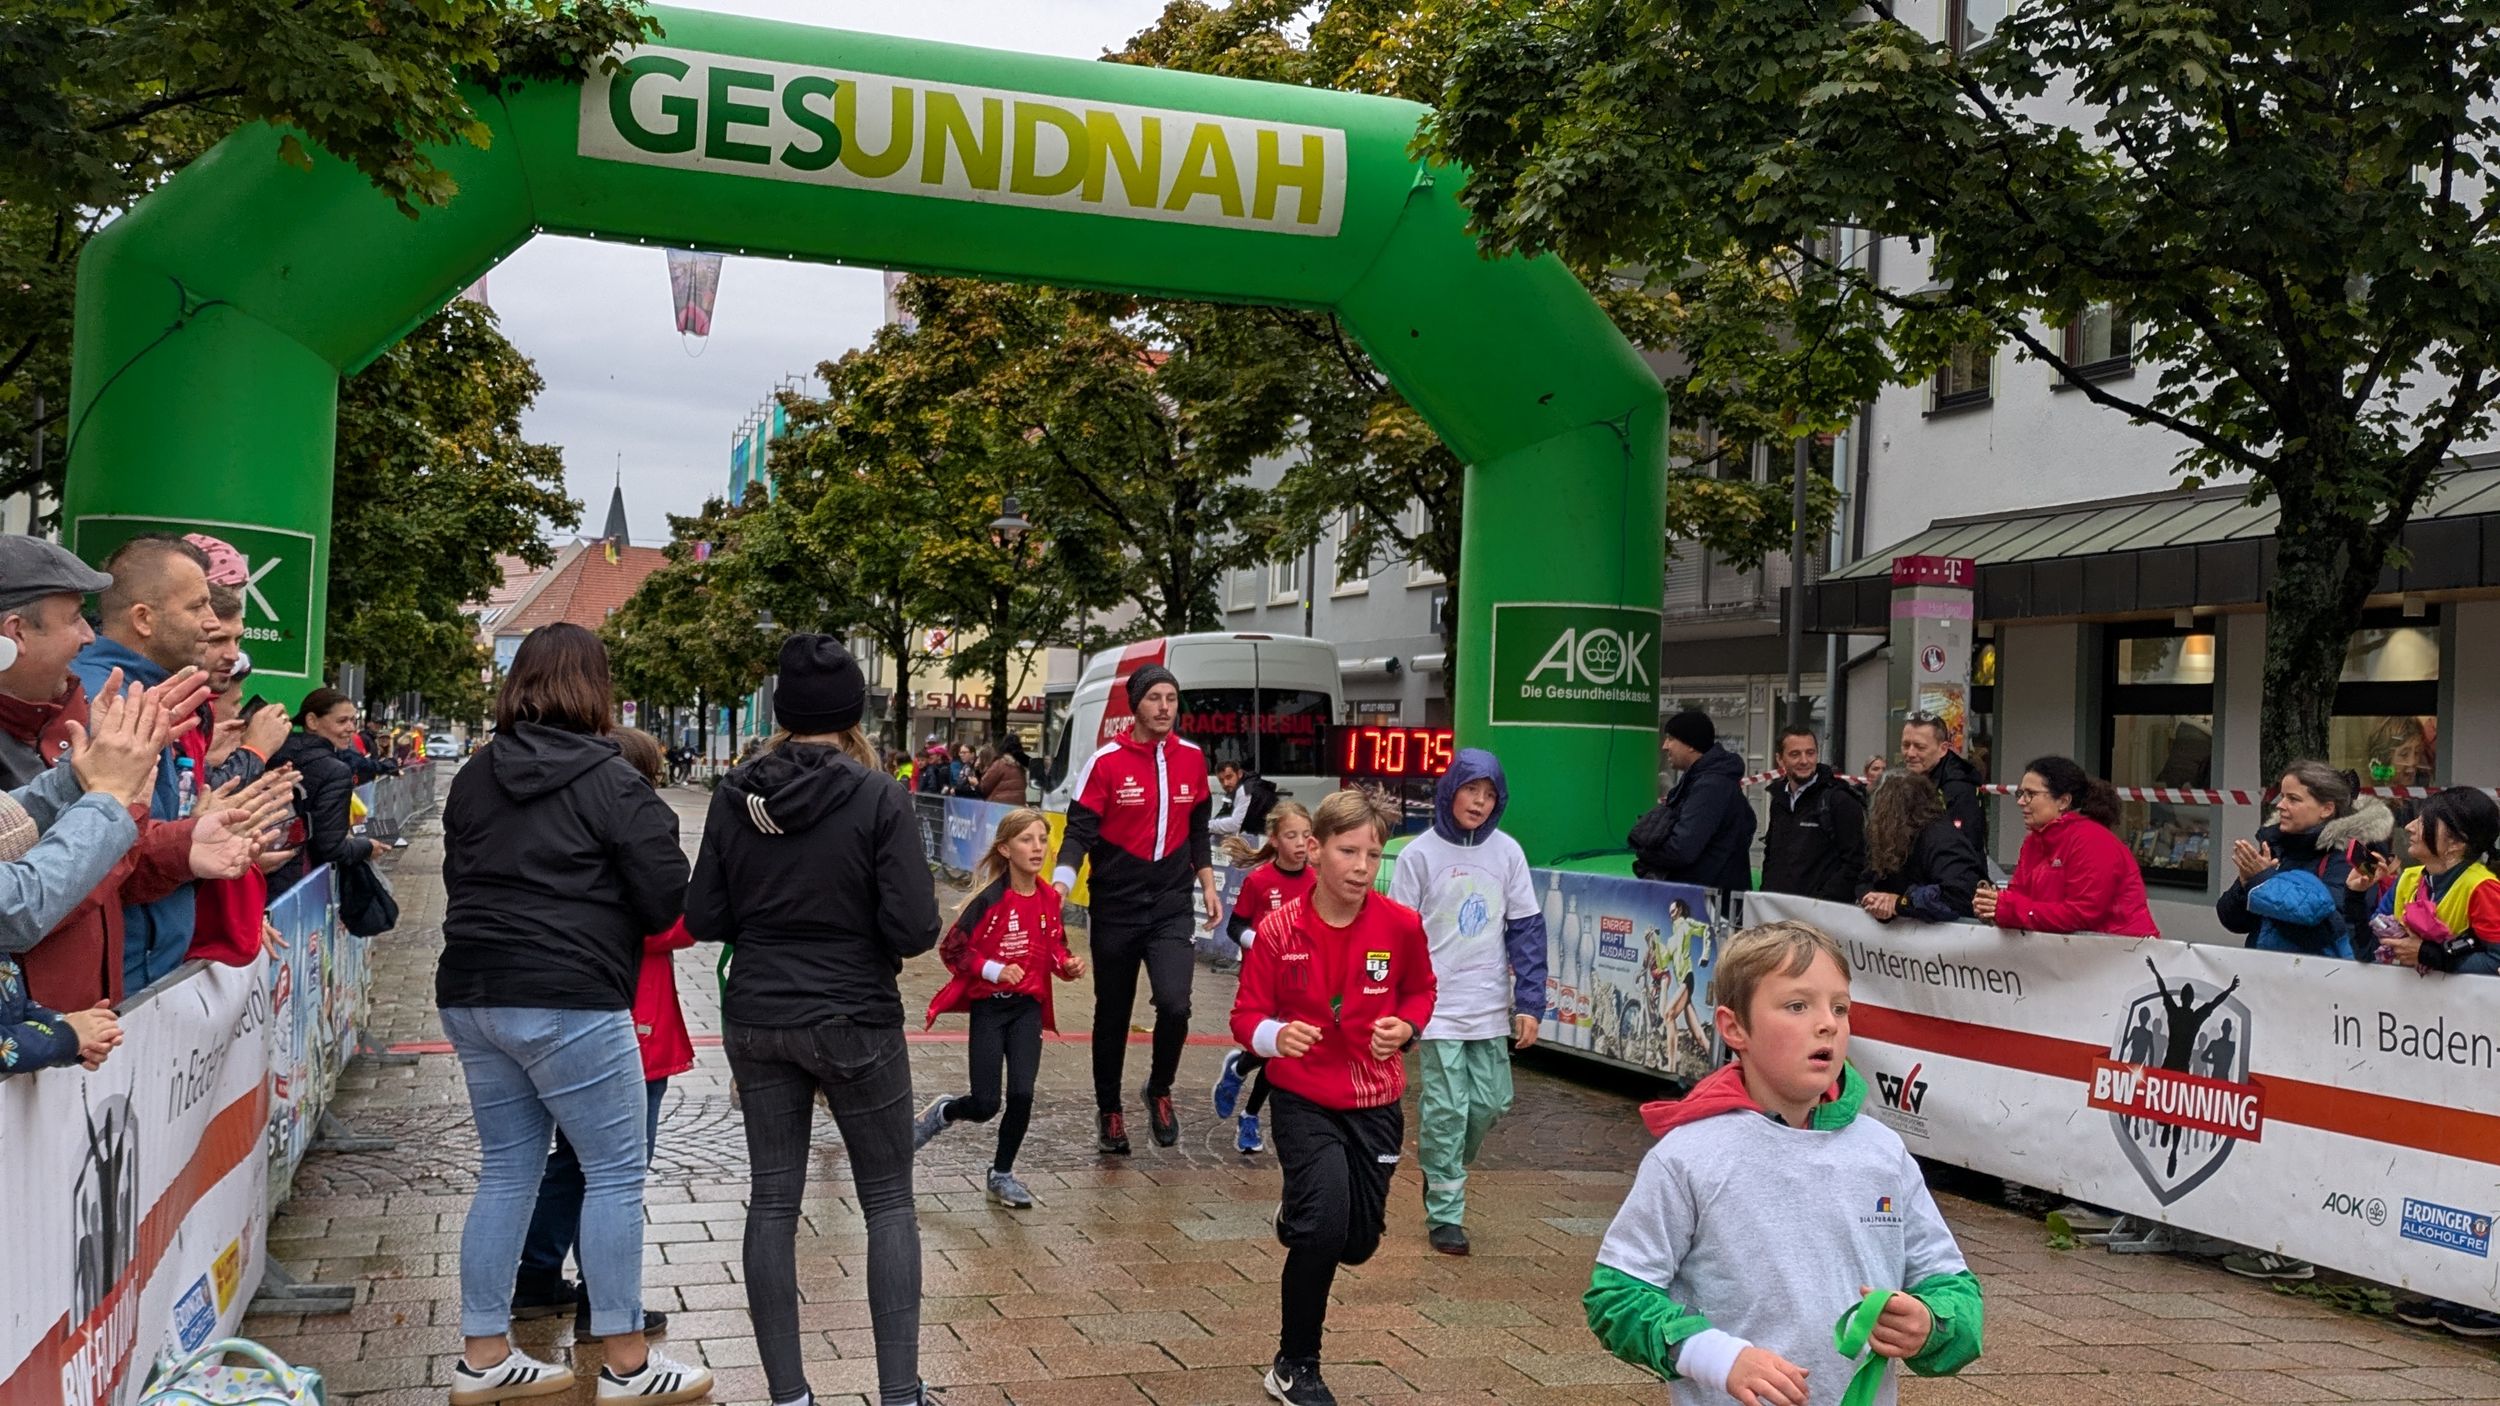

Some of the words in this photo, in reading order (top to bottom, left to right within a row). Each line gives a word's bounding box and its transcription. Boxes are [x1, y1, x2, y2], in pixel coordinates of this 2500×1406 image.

[608, 55, 1326, 226] GESUNDNAH
[1525, 627, 1651, 686] AOK
[1521, 684, 1542, 699] Die
[1602, 917, 1632, 932] ENERGIE
[1602, 932, 1624, 944] KRAFT
[1849, 939, 2022, 996] Unternehmen
[2333, 1003, 2362, 1048] in
[2093, 1067, 2258, 1132] BW-RUNNING
[2322, 1192, 2364, 1220] AOK
[2404, 1200, 2473, 1235] ERDINGER
[2402, 1220, 2488, 1251] ALKOHOLFREI
